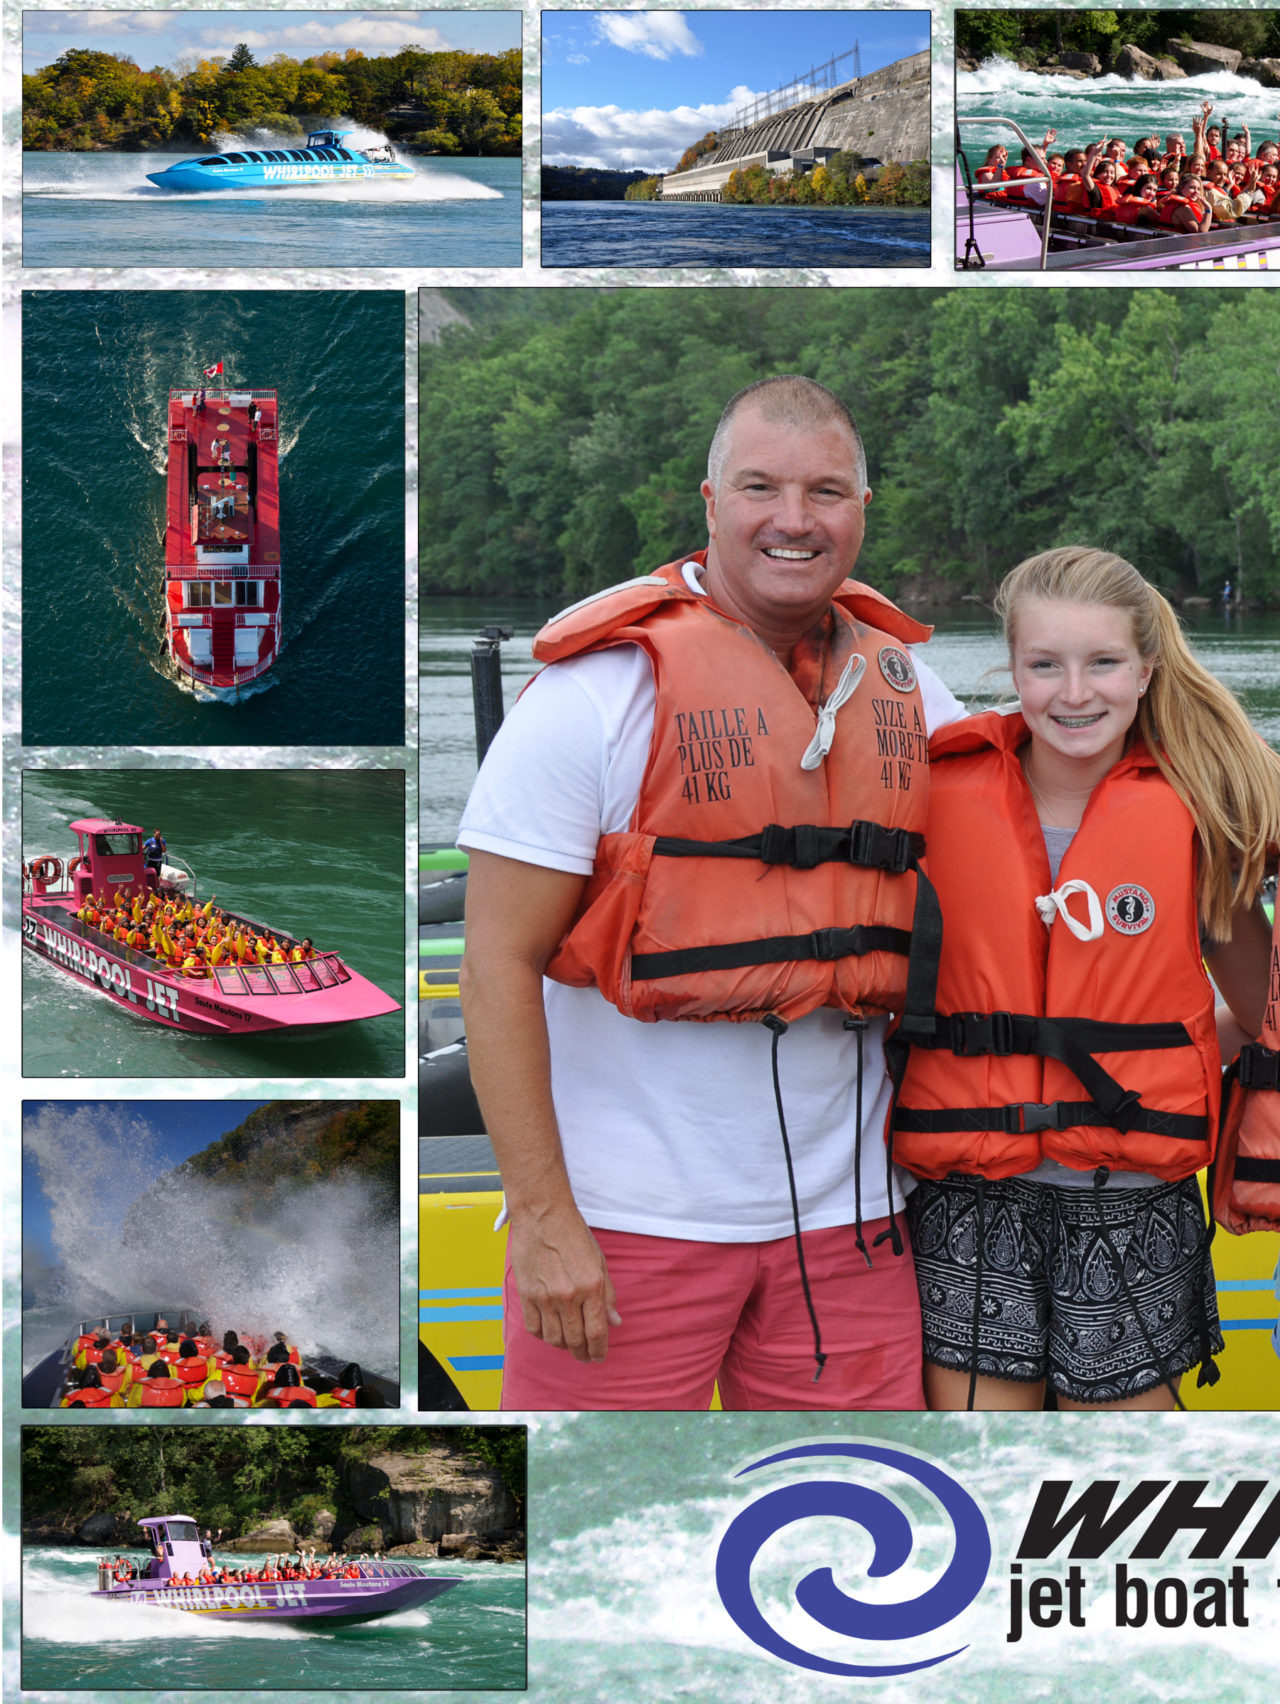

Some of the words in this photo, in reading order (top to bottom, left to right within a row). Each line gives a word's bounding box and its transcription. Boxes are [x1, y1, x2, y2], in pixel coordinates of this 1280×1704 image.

[263, 165, 335, 179] WHIRLPOOL
[340, 165, 356, 178] JET
[675, 708, 749, 743] TAILLE
[758, 707, 770, 736] A
[872, 699, 907, 729] SIZE
[914, 704, 922, 732] A
[678, 740, 724, 775] PLUS
[727, 737, 755, 768] DE
[876, 729, 914, 760] MORE
[681, 775, 700, 805] 41
[705, 771, 731, 802] KG
[880, 761, 893, 789] 41
[898, 761, 911, 791] KG
[1112, 888, 1149, 904] MUSTANG
[1112, 913, 1149, 930] SURVIVAL
[43, 925, 137, 1004] WHIRLPOOL
[146, 979, 180, 1022] JET
[195, 997, 213, 1010] Saute
[214, 1003, 243, 1020] Moutons
[244, 1013, 252, 1022] 17
[1265, 1004, 1277, 1031] 41
[153, 1584, 268, 1611] WHIRLPOOL
[275, 1583, 308, 1607] JET
